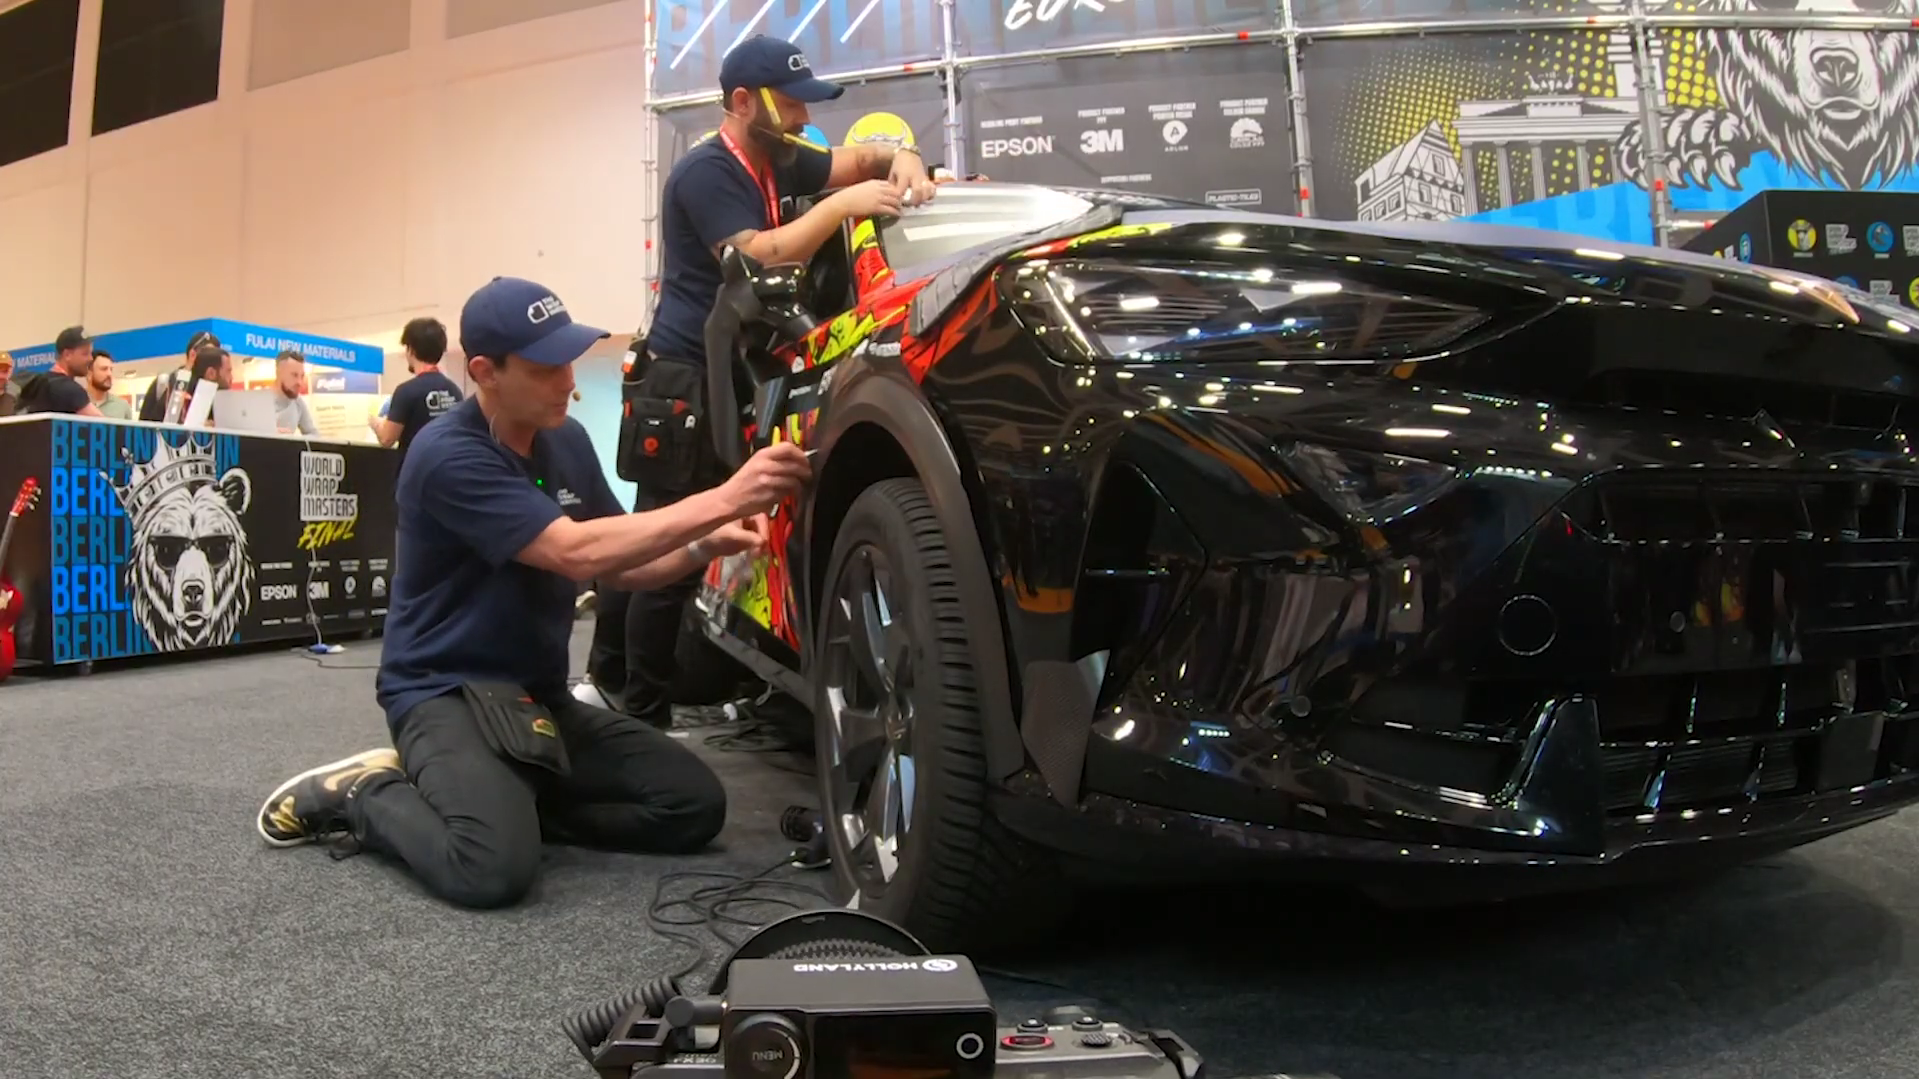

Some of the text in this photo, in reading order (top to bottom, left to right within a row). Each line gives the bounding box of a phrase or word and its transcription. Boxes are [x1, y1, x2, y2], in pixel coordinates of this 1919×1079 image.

[980, 136, 1053, 158] EPSON
[1079, 128, 1124, 154] 3M
[246, 333, 356, 363] FULAI NEW MATERIALS
[303, 456, 342, 476] WORLD
[303, 477, 336, 496] WRAP
[303, 498, 355, 517] MASTERS
[260, 584, 298, 600] EPSON
[309, 581, 330, 599] 3M
[793, 962, 918, 972] HOLLYLAND
[752, 1050, 783, 1061] MENU
